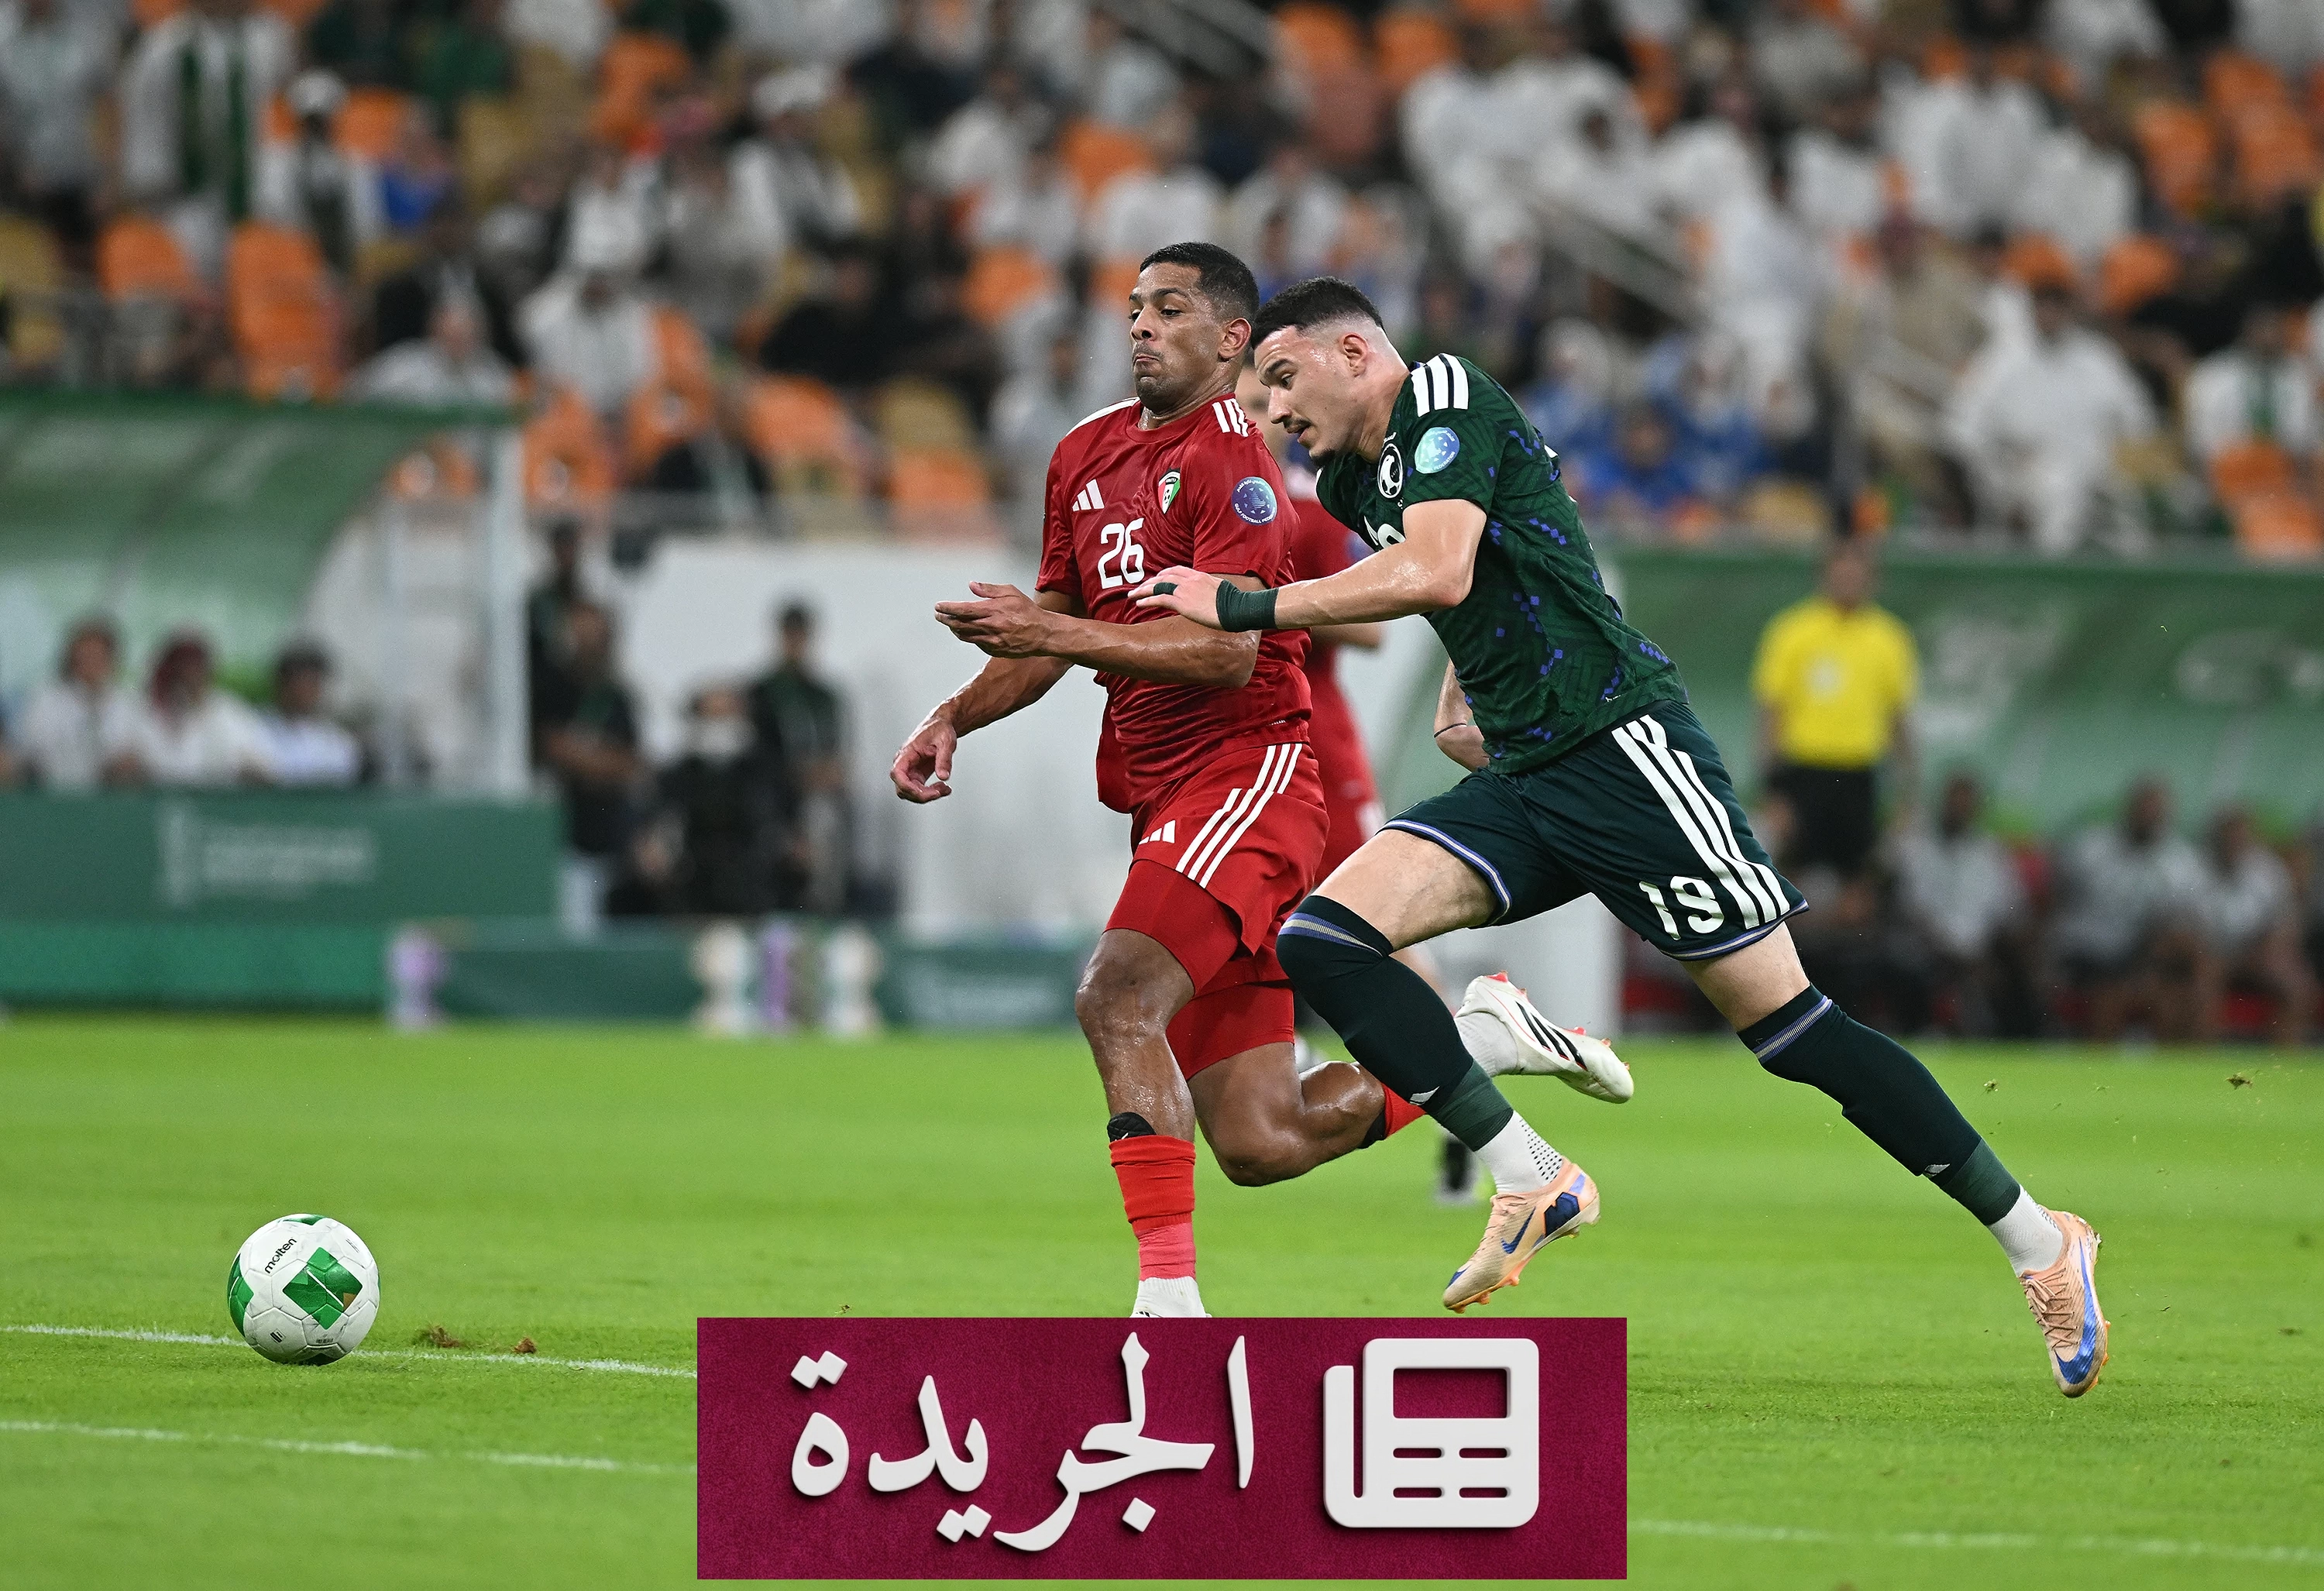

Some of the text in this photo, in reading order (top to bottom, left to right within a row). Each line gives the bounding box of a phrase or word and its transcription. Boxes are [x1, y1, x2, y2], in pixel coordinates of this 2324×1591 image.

[1240, 513, 1261, 523] FOOTBALL
[1098, 517, 1145, 589] 26
[1638, 875, 1724, 940] 19
[264, 1239, 297, 1274] molten
